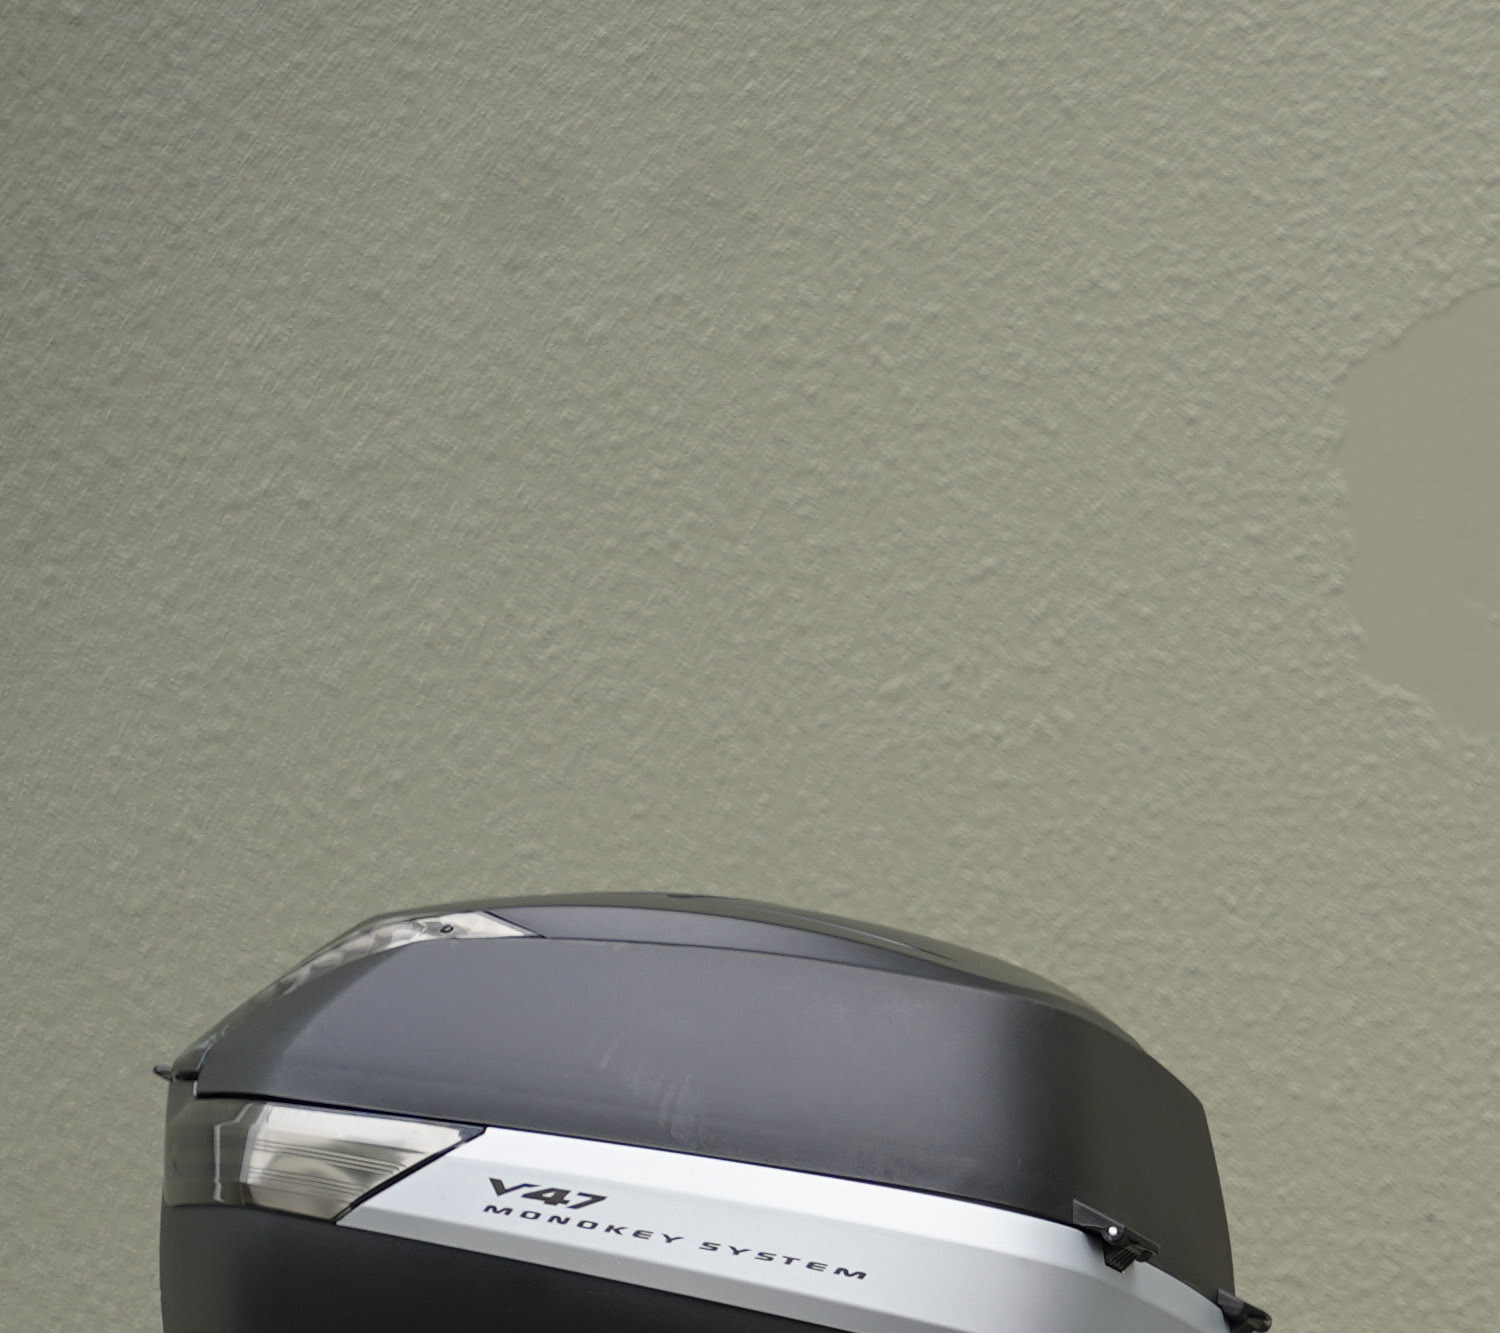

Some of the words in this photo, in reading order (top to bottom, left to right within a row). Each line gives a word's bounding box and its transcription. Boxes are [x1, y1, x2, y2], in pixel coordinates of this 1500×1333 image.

[488, 1177, 608, 1210] V47
[483, 1204, 684, 1245] MONOKEY
[699, 1241, 867, 1281] SYSTEM
